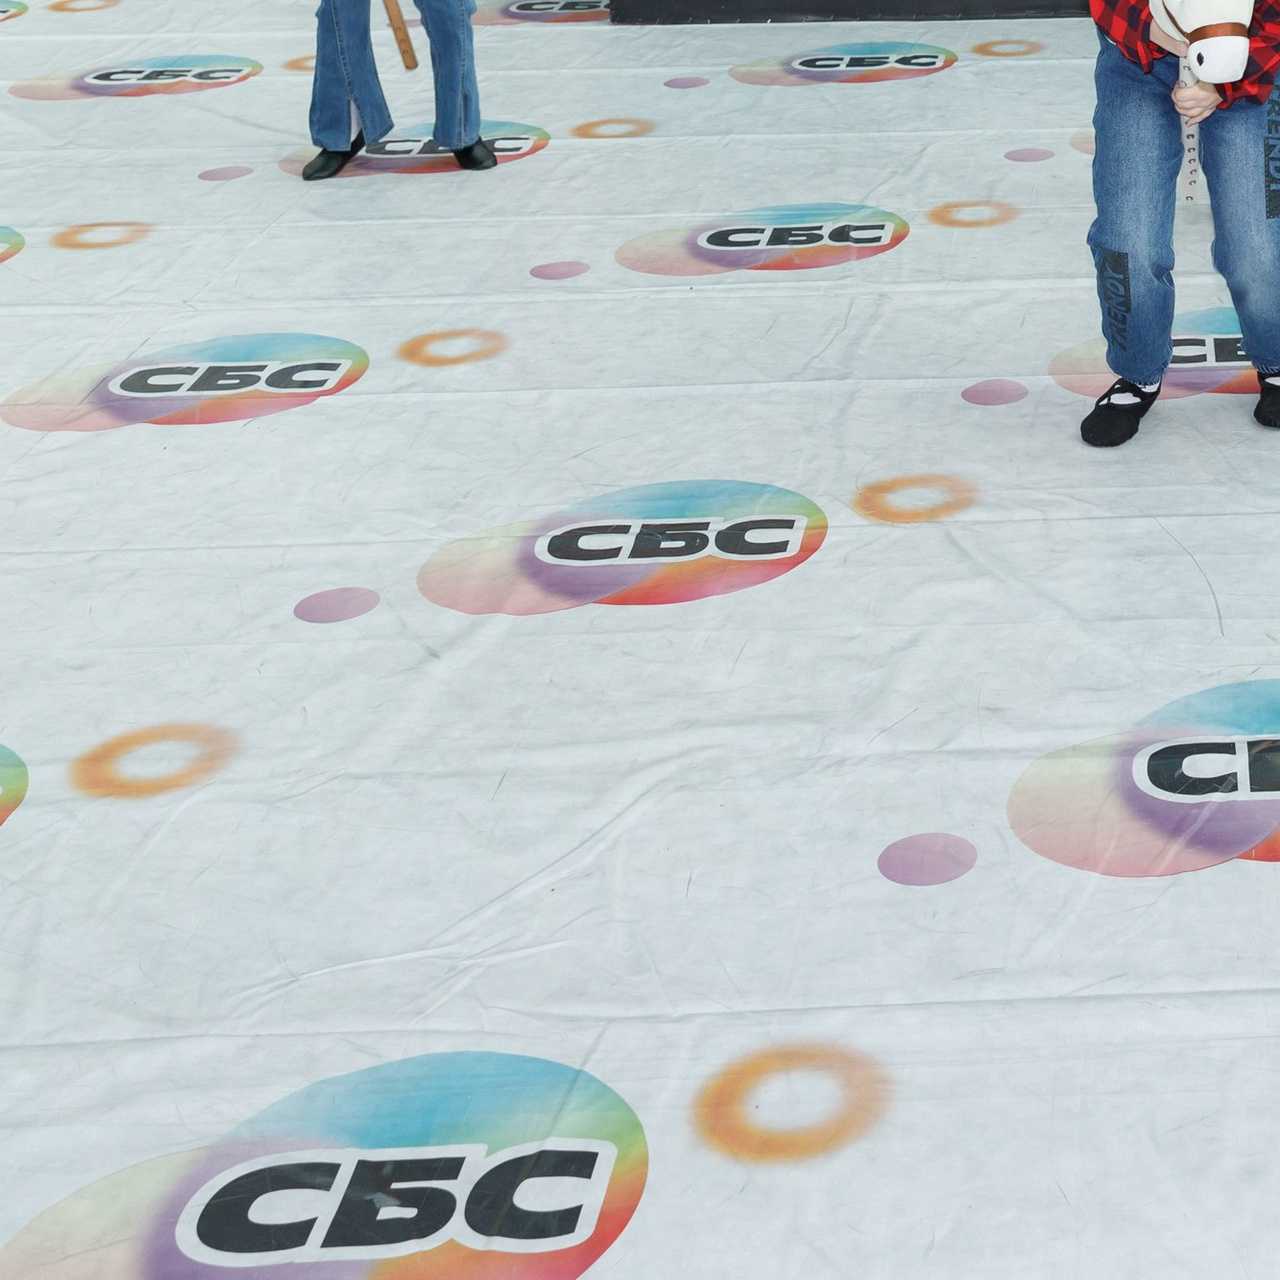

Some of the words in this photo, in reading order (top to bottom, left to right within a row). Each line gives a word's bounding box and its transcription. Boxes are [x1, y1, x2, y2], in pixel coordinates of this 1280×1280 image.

[516, 0, 610, 11] СБ
[798, 54, 938, 69] СБС
[92, 67, 233, 84] СБС
[705, 224, 885, 248] СБС
[121, 361, 348, 395] СБС
[547, 518, 799, 562] СБС
[196, 1149, 600, 1254] СБС
